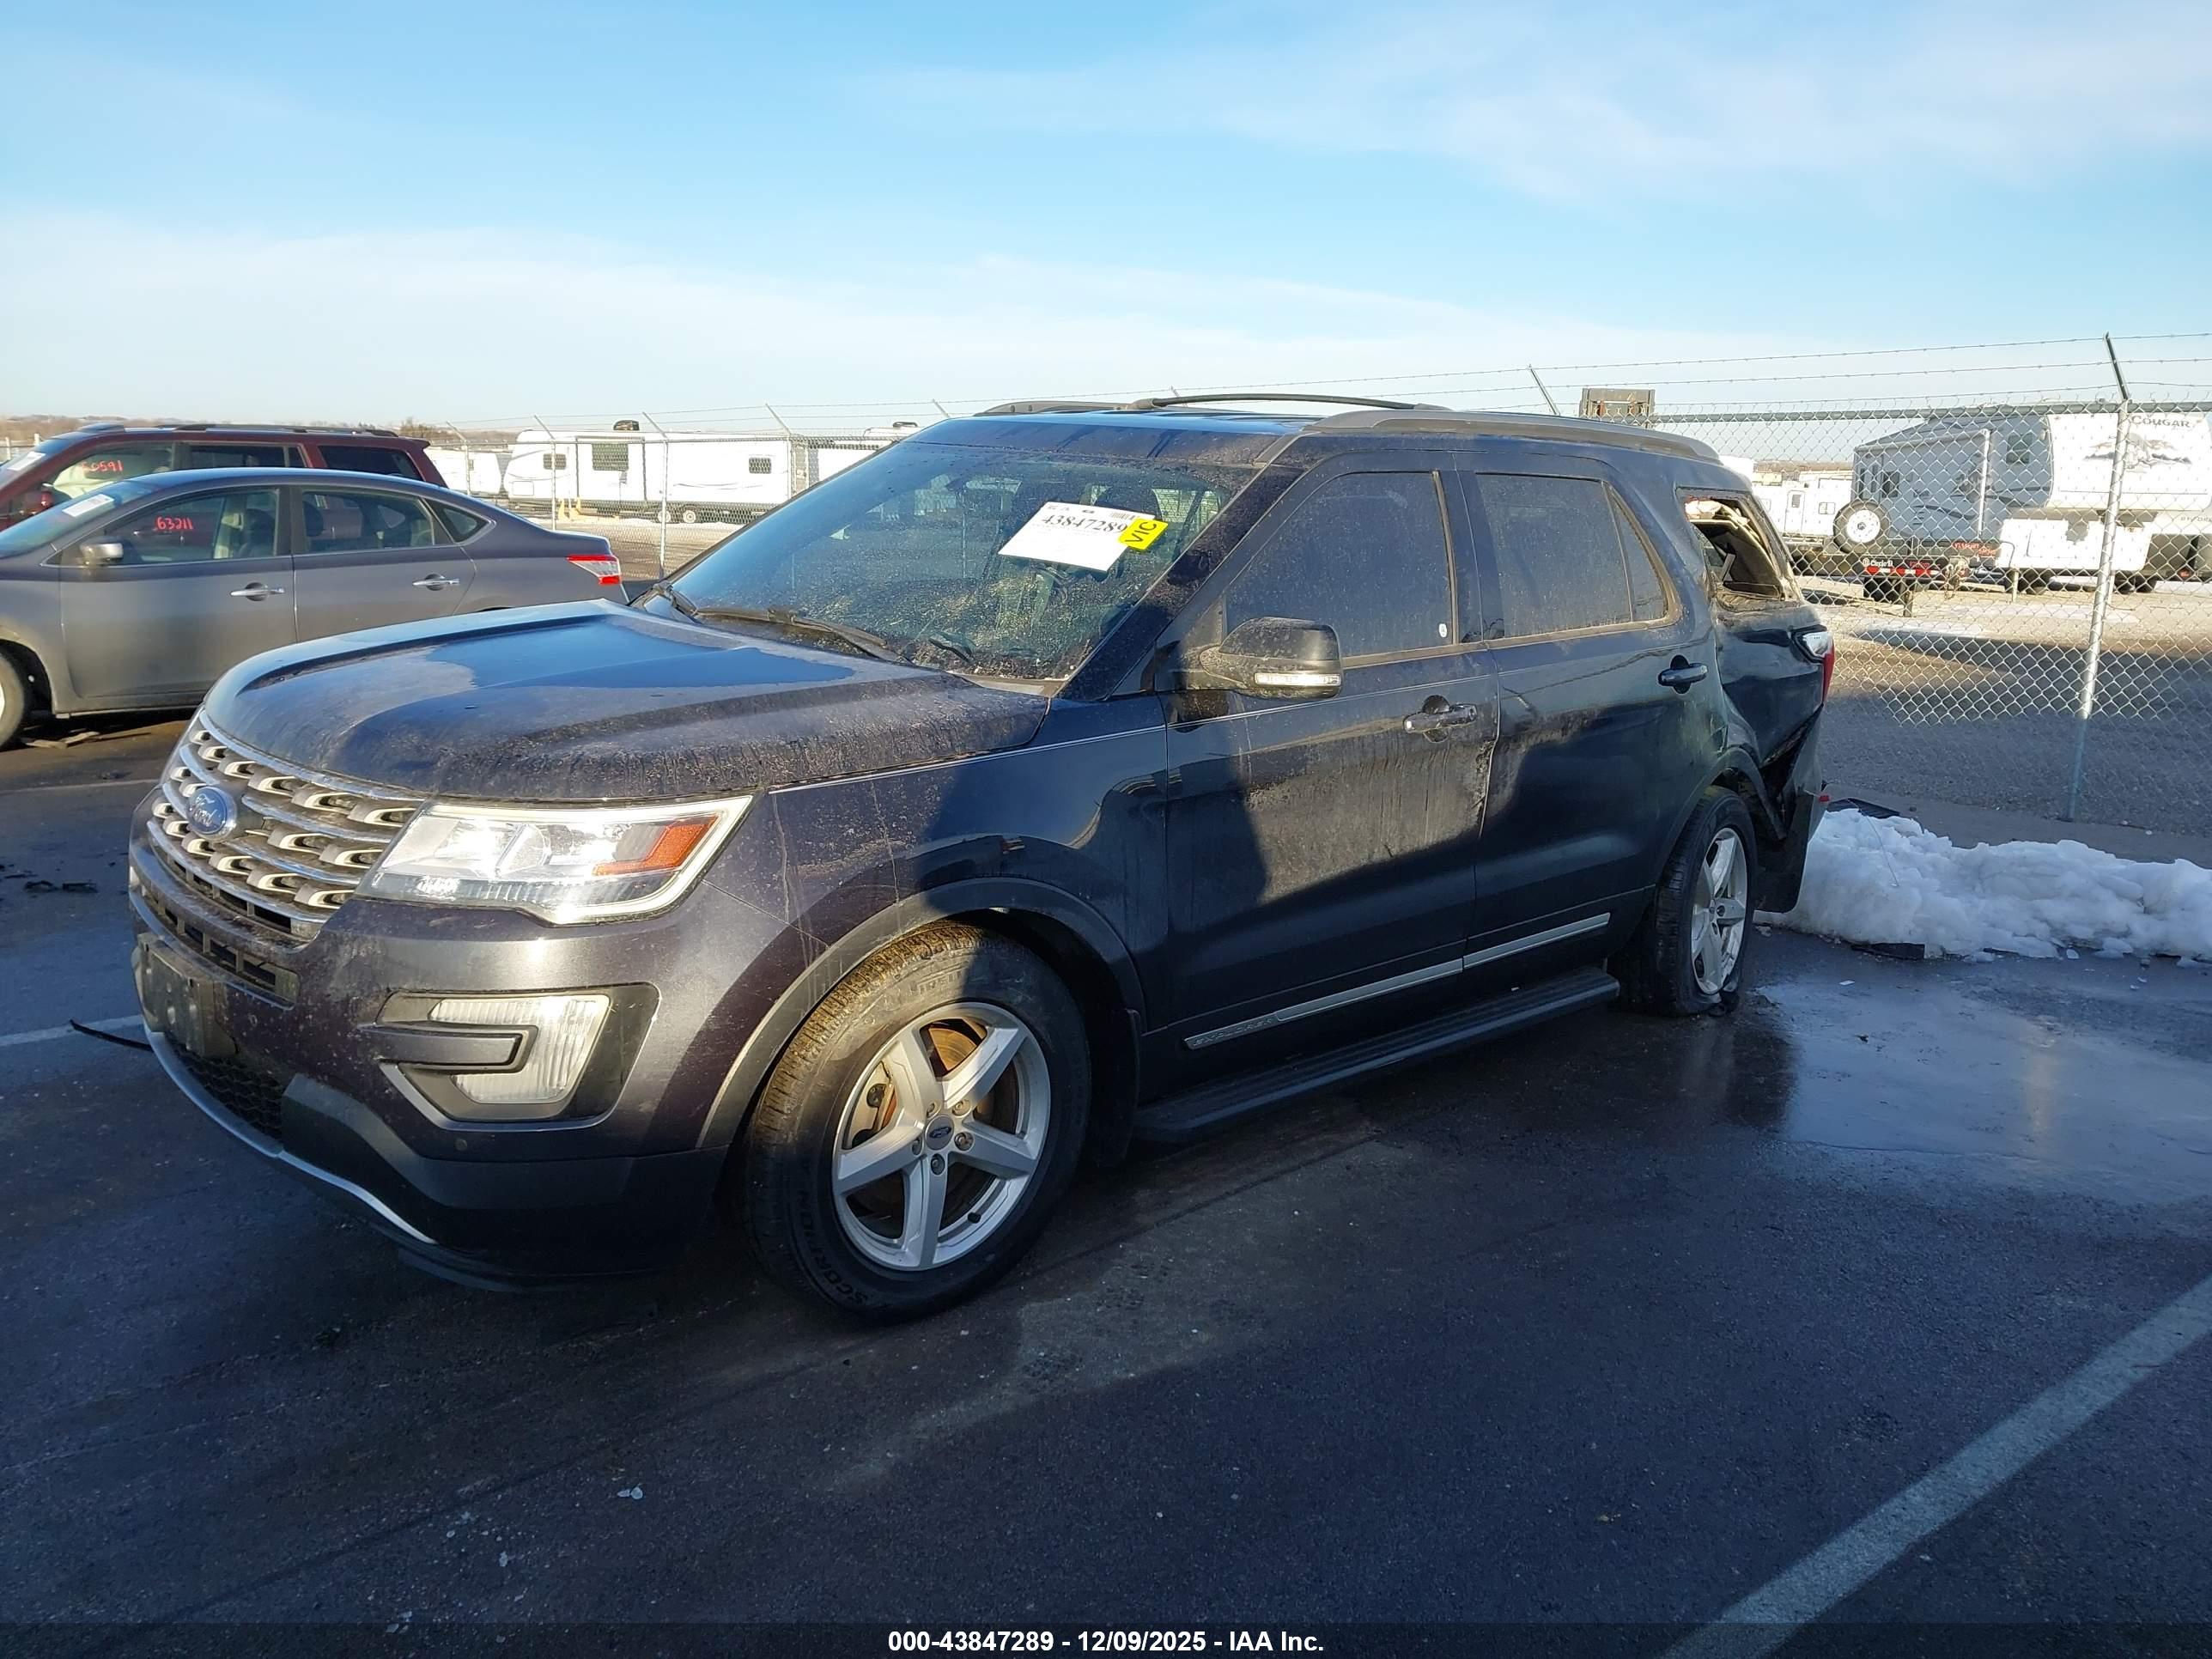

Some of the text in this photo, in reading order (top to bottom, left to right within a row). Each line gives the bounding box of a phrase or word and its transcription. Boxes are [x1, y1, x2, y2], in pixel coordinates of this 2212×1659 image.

[1042, 514, 1127, 533] 43847289
[1125, 521, 1157, 544] VIC
[195, 793, 218, 827] Ford
